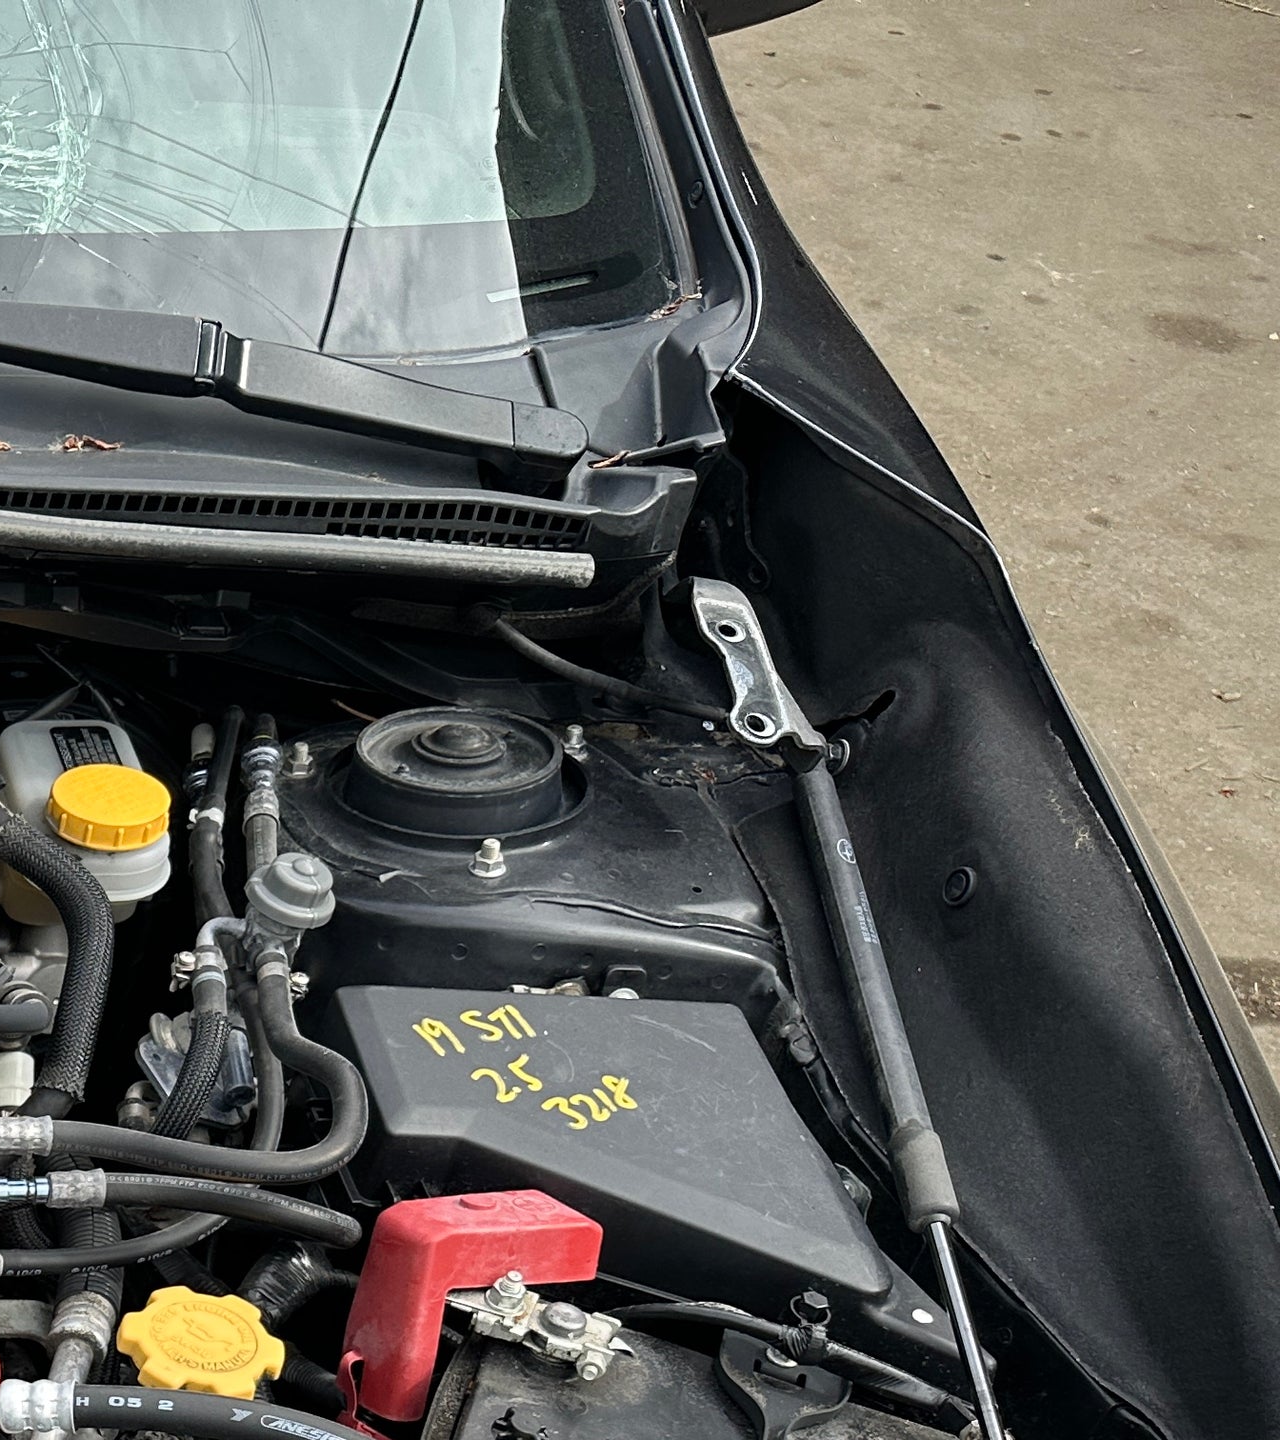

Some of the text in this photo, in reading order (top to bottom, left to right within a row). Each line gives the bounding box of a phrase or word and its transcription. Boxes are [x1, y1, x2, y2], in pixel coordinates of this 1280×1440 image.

[412, 1004, 536, 1056] 19 STI
[541, 1075, 638, 1130] 3218
[108, 1396, 142, 1408] 05
[158, 1399, 174, 1411] 2
